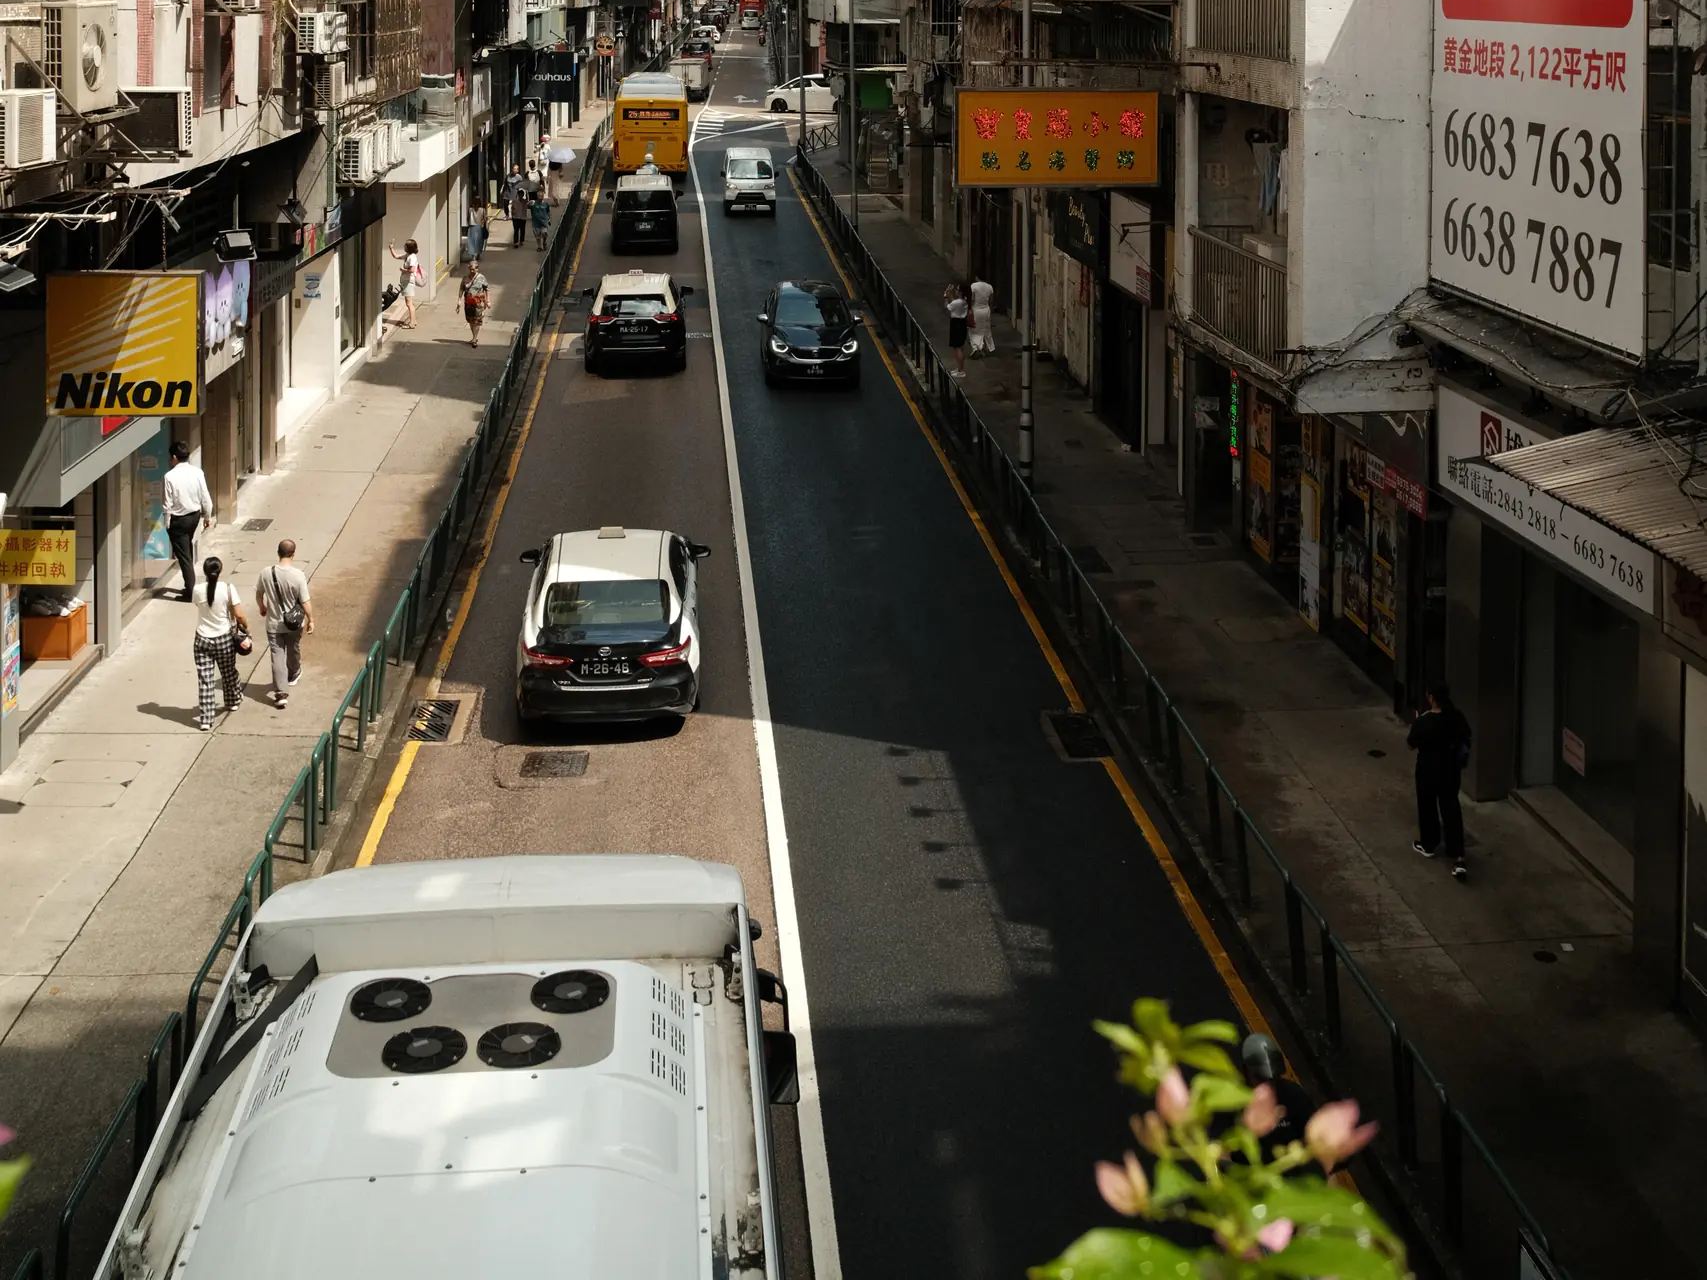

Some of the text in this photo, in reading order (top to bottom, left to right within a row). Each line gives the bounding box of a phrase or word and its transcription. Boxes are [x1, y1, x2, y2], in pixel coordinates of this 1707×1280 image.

[1444, 107, 1623, 207] 6683 7638
[1443, 196, 1623, 311] 6638 7887
[619, 325, 649, 333] MA-25-17
[54, 372, 193, 409] Nikon
[0, 536, 70, 553] 攝影器材
[1527, 506, 1557, 541] 2818
[1573, 533, 1605, 570] 6683
[1609, 553, 1645, 594] 7638
[580, 662, 630, 675] M-26-46
